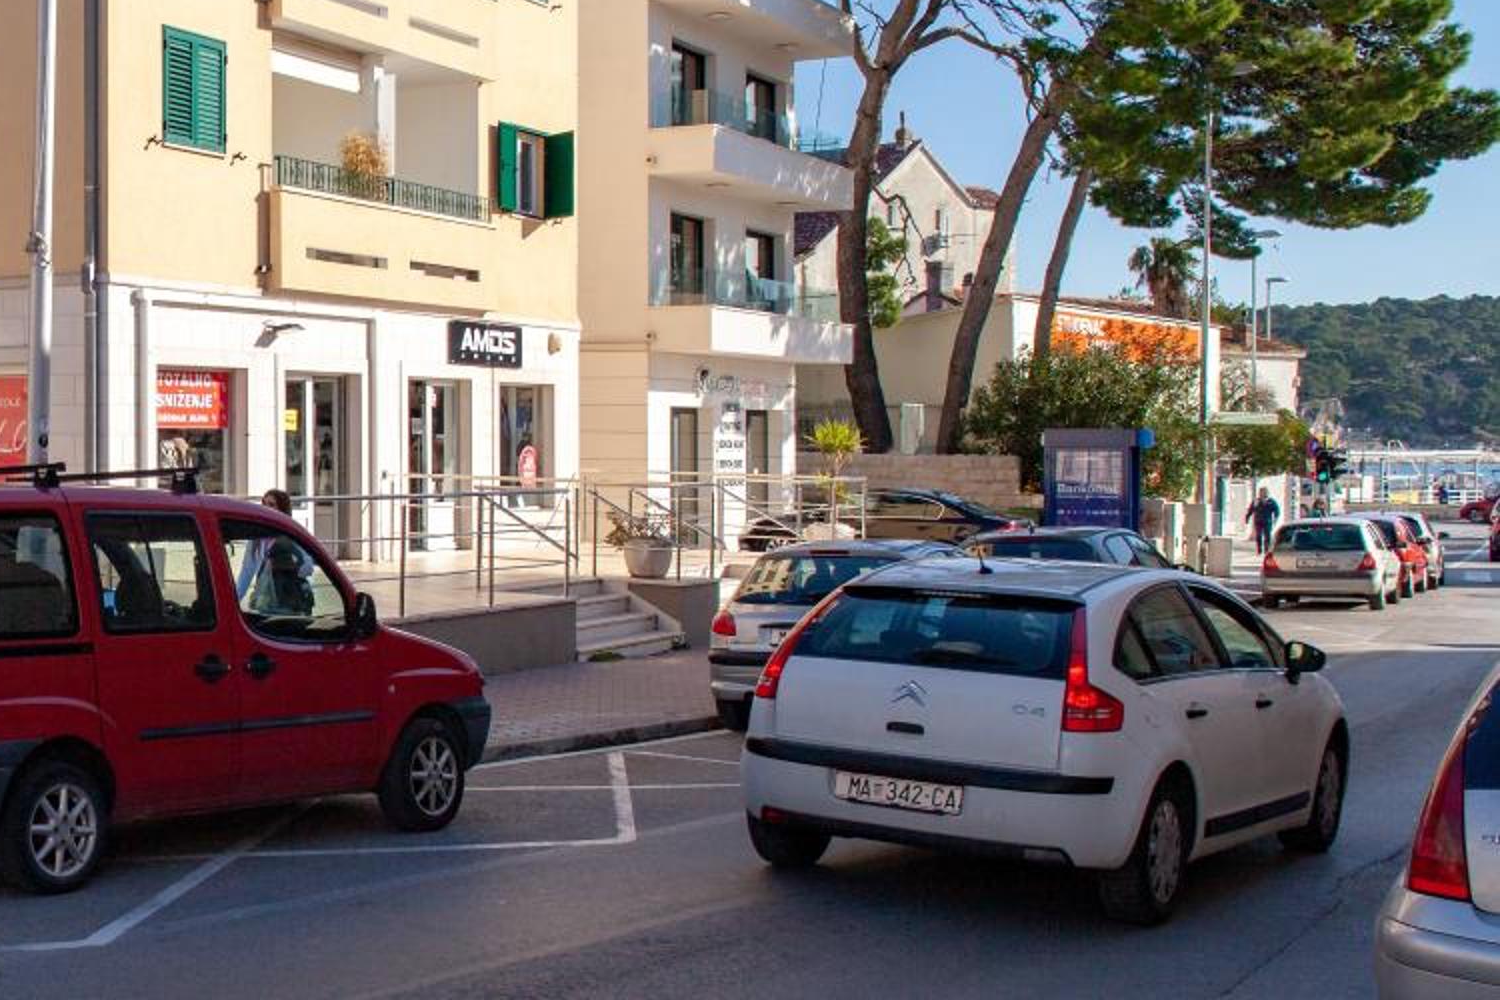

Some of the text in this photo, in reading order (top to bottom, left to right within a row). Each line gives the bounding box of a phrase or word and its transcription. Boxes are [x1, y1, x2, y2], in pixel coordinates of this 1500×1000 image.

[158, 372, 212, 388] TOTALNO
[155, 389, 213, 408] SNIŽENJE
[847, 777, 956, 809] MA 342-CA
